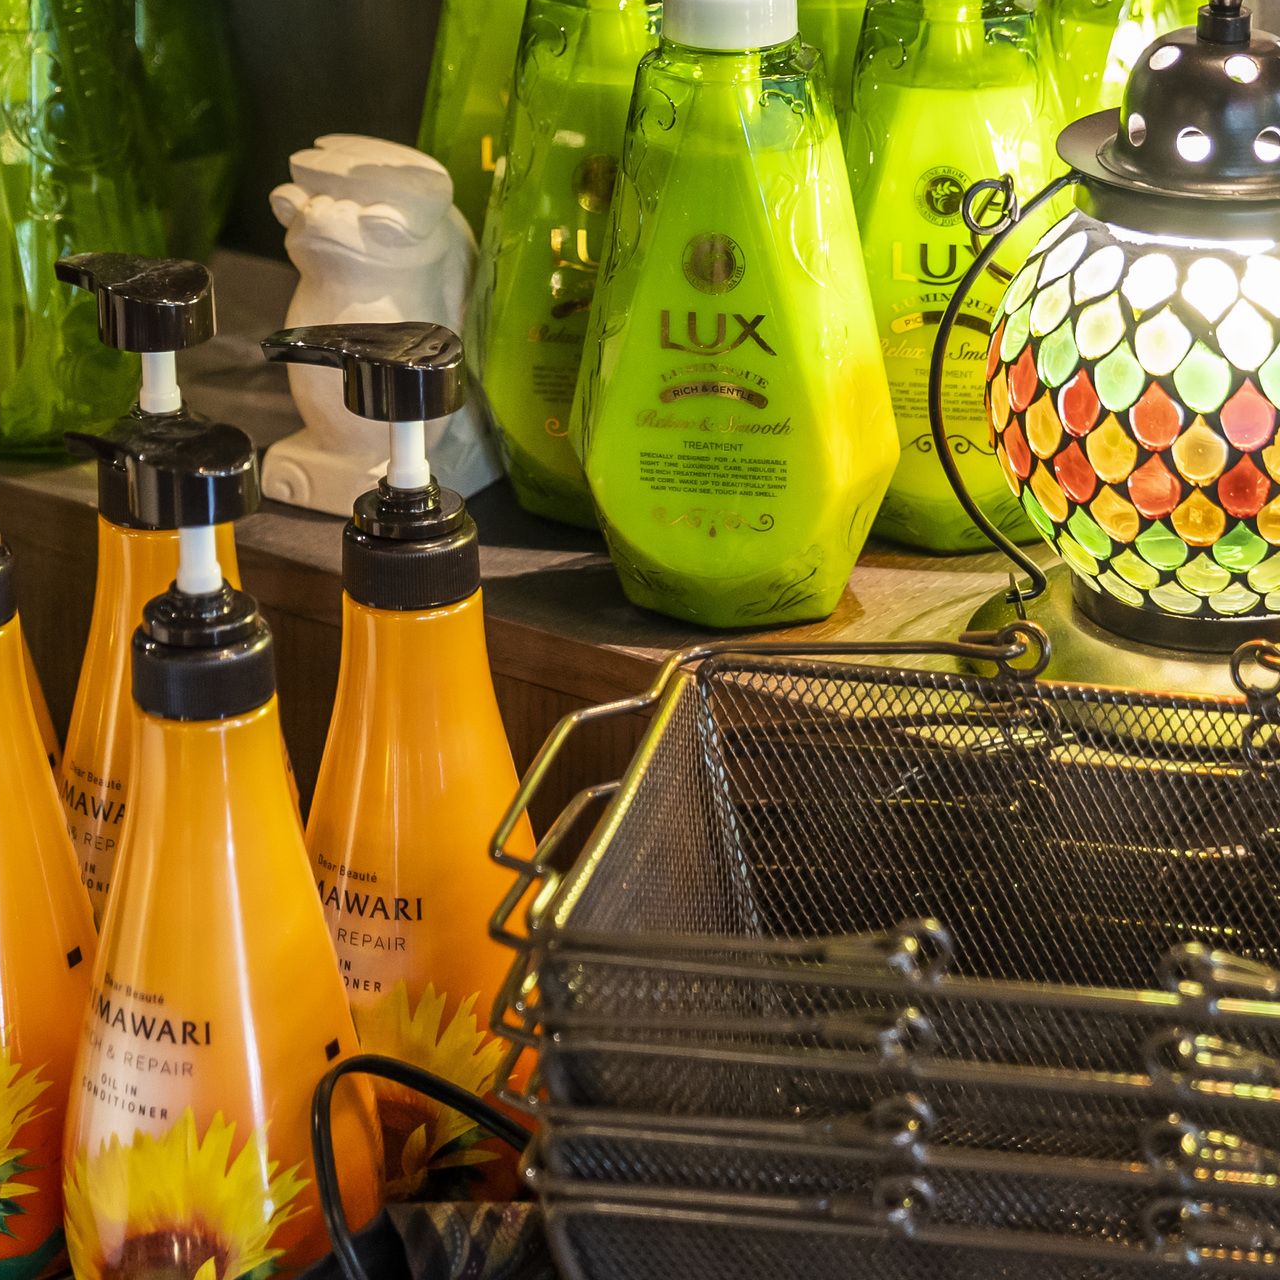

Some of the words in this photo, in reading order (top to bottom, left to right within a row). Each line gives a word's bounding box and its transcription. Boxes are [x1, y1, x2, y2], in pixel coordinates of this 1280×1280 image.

[660, 310, 777, 356] LUX
[673, 385, 698, 398] RICH
[702, 385, 710, 393] &
[712, 385, 754, 402] GENTLE
[720, 415, 794, 435] Smooth
[683, 440, 744, 452] TREATMENT
[677, 454, 711, 462] DESIGNED
[62, 779, 126, 825] MAWA
[83, 832, 116, 852] REP
[339, 865, 378, 884] Beauté
[337, 927, 407, 952] REPAIR
[90, 986, 211, 1045] IMAWARI
[106, 1044, 115, 1060] &
[123, 1051, 193, 1078] REPAIR
[101, 1073, 118, 1090] OIL
[125, 1084, 137, 1097] IN
